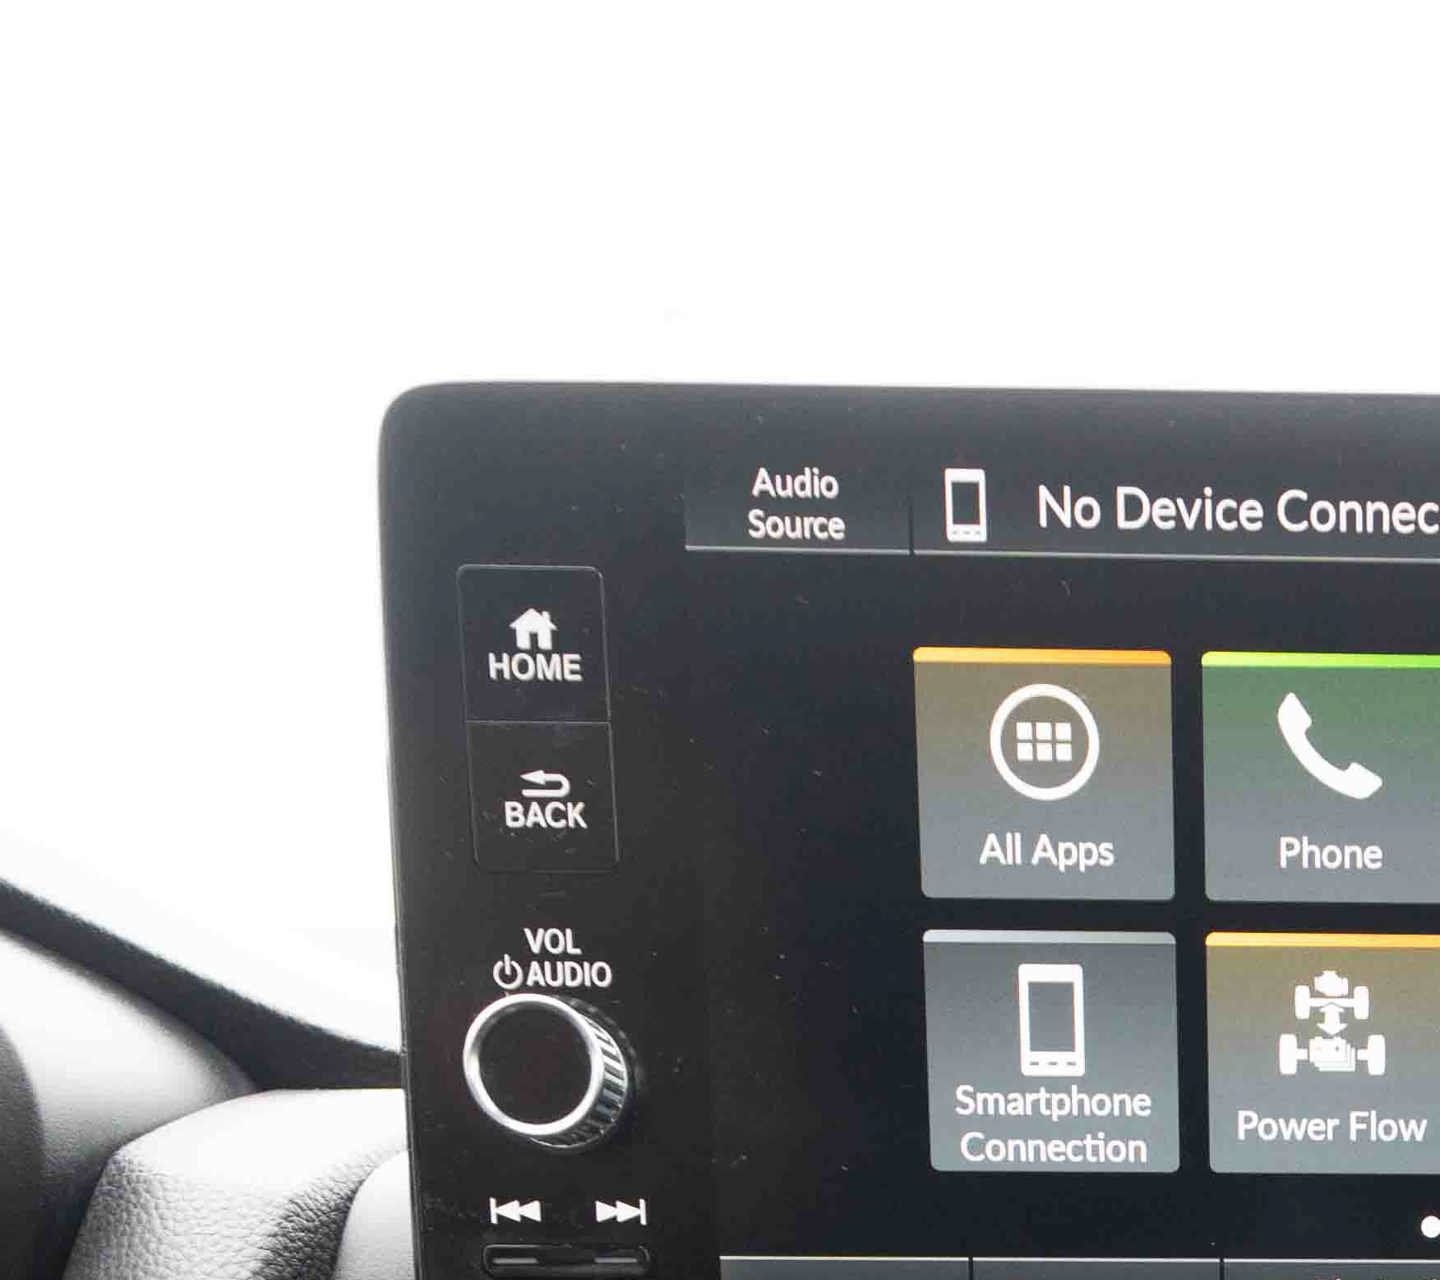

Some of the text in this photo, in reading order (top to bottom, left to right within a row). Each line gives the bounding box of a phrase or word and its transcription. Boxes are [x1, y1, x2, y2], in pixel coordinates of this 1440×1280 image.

[751, 466, 839, 499] Audio
[748, 508, 846, 540] Source
[1038, 484, 1101, 529] No
[1116, 485, 1264, 532] Device
[488, 652, 583, 683] HOME
[504, 800, 588, 831] BACK
[979, 832, 1115, 873] All Apps
[1279, 835, 1383, 870] Phone
[523, 927, 582, 955] VOL
[526, 960, 613, 988] AUDIO
[955, 1084, 1152, 1122] Smartphone
[1237, 1109, 1428, 1142] Power Flow
[960, 1131, 1148, 1163] Connection
